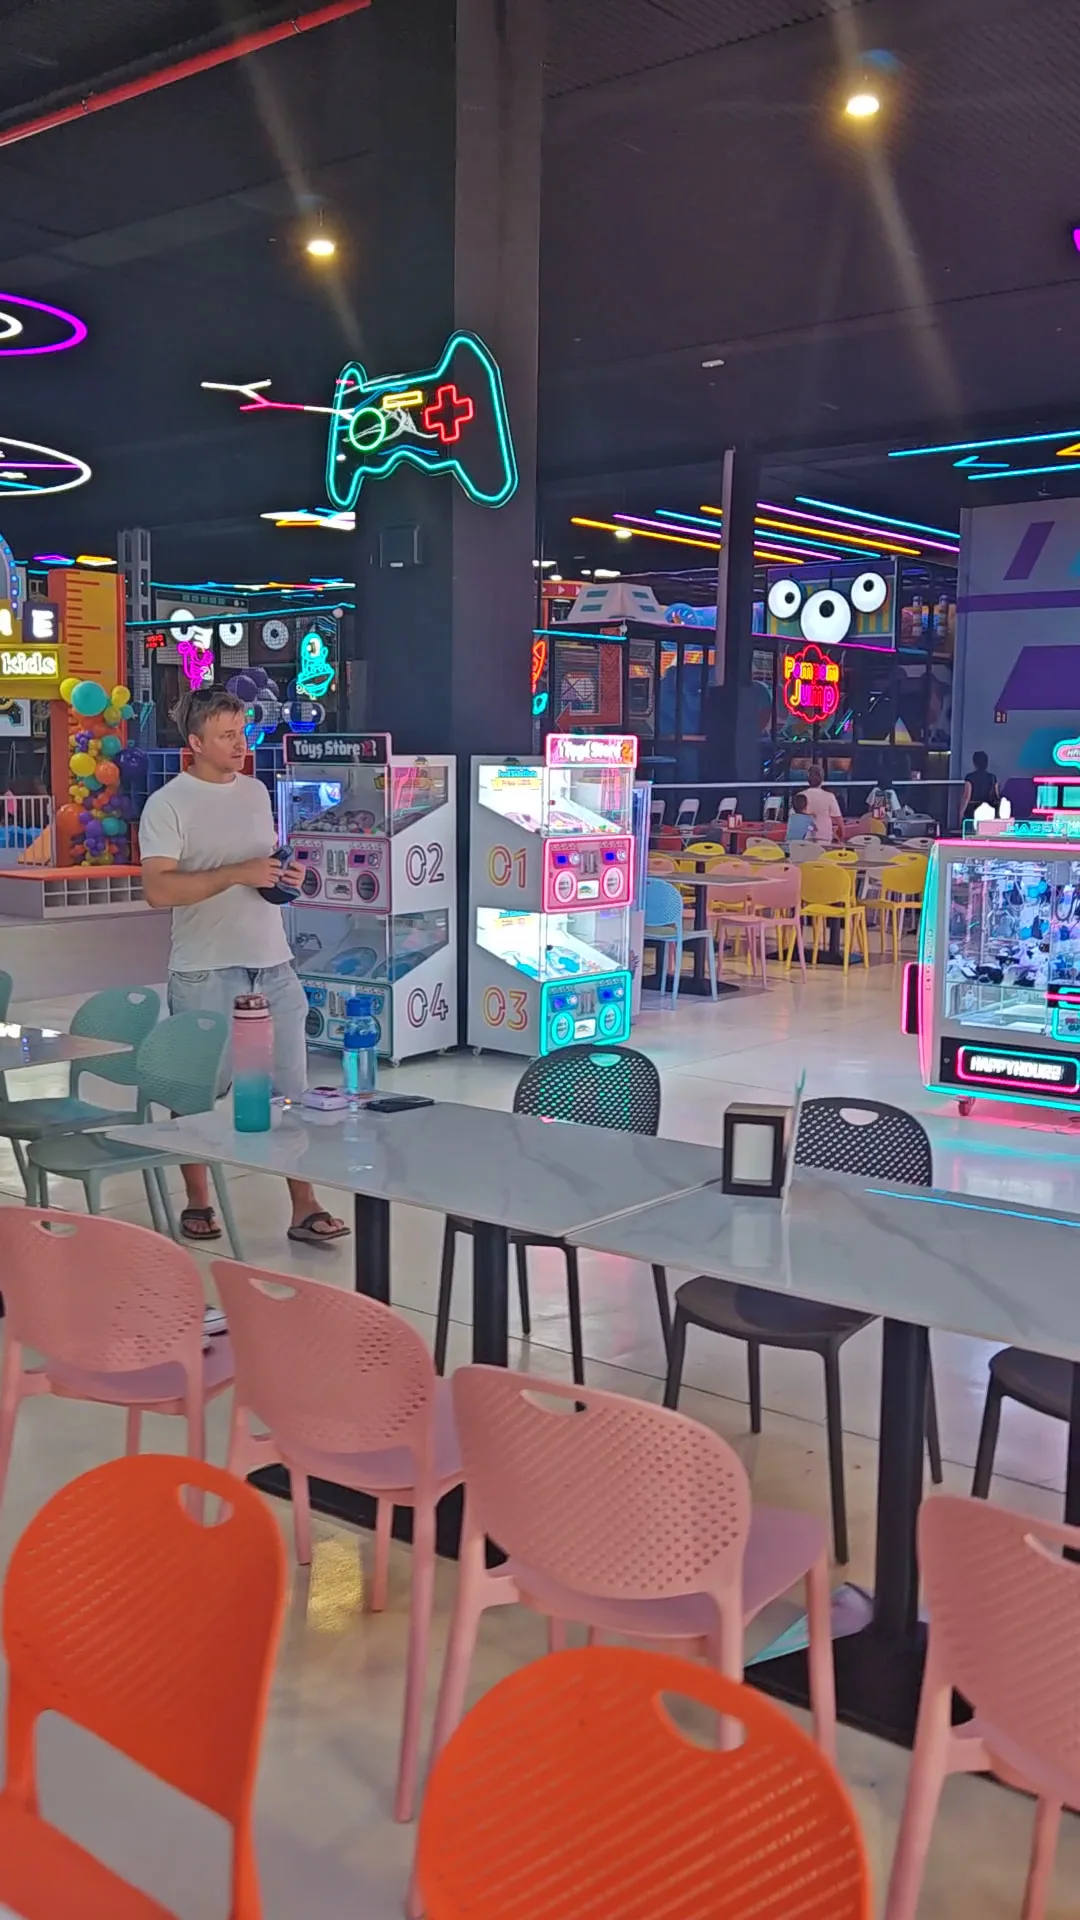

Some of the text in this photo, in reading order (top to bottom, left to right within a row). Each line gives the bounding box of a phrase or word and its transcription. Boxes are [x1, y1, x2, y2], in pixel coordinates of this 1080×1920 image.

[1, 651, 56, 675] kids
[784, 656, 840, 684] Pompom
[790, 679, 835, 713] Jump
[293, 740, 323, 759] Toys
[324, 740, 360, 757] Store
[405, 842, 444, 886] 02
[488, 846, 527, 888] 01
[407, 983, 449, 1028] 04
[483, 986, 529, 1031] 03
